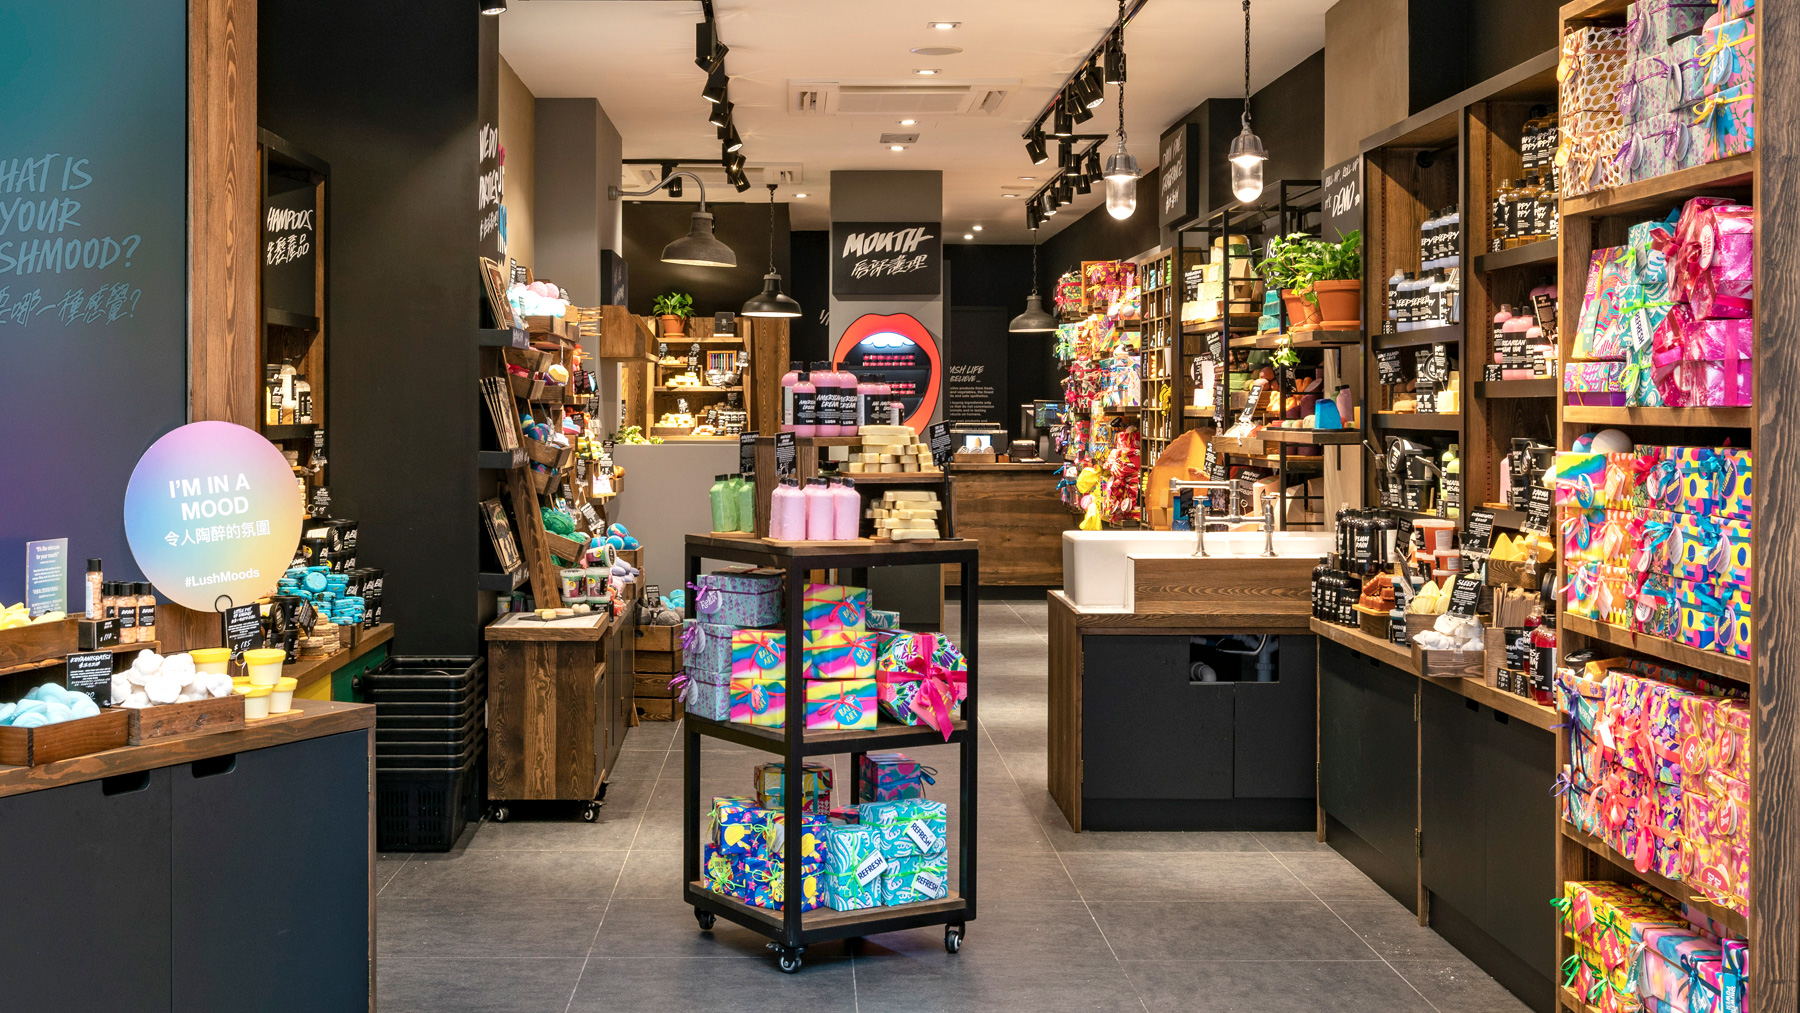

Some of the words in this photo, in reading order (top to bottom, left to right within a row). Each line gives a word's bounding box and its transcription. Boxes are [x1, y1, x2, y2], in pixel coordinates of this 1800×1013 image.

[61, 156, 93, 192] IS
[0, 197, 82, 235] YOUR
[842, 227, 934, 258] MOUTH
[0, 234, 142, 276] SHMOOD?
[1635, 311, 1645, 346] REFRESH
[967, 365, 984, 374] LIFE
[169, 477, 201, 499] I’M
[207, 474, 229, 494] IN
[235, 473, 251, 491] A
[180, 496, 249, 521] MOOD
[164, 519, 271, 547] 令人陶醉的氛圍
[184, 567, 260, 588] #LushMoods
[1456, 579, 1480, 588] SLEEPY
[700, 593, 718, 609] Relax
[842, 603, 855, 618] BAH
[763, 653, 775, 665] ART
[862, 650, 871, 662] ART
[845, 710, 858, 722] ART
[911, 822, 932, 847] REFRESH
[857, 857, 883, 880] REFRESH
[916, 875, 939, 891] REFRESH
